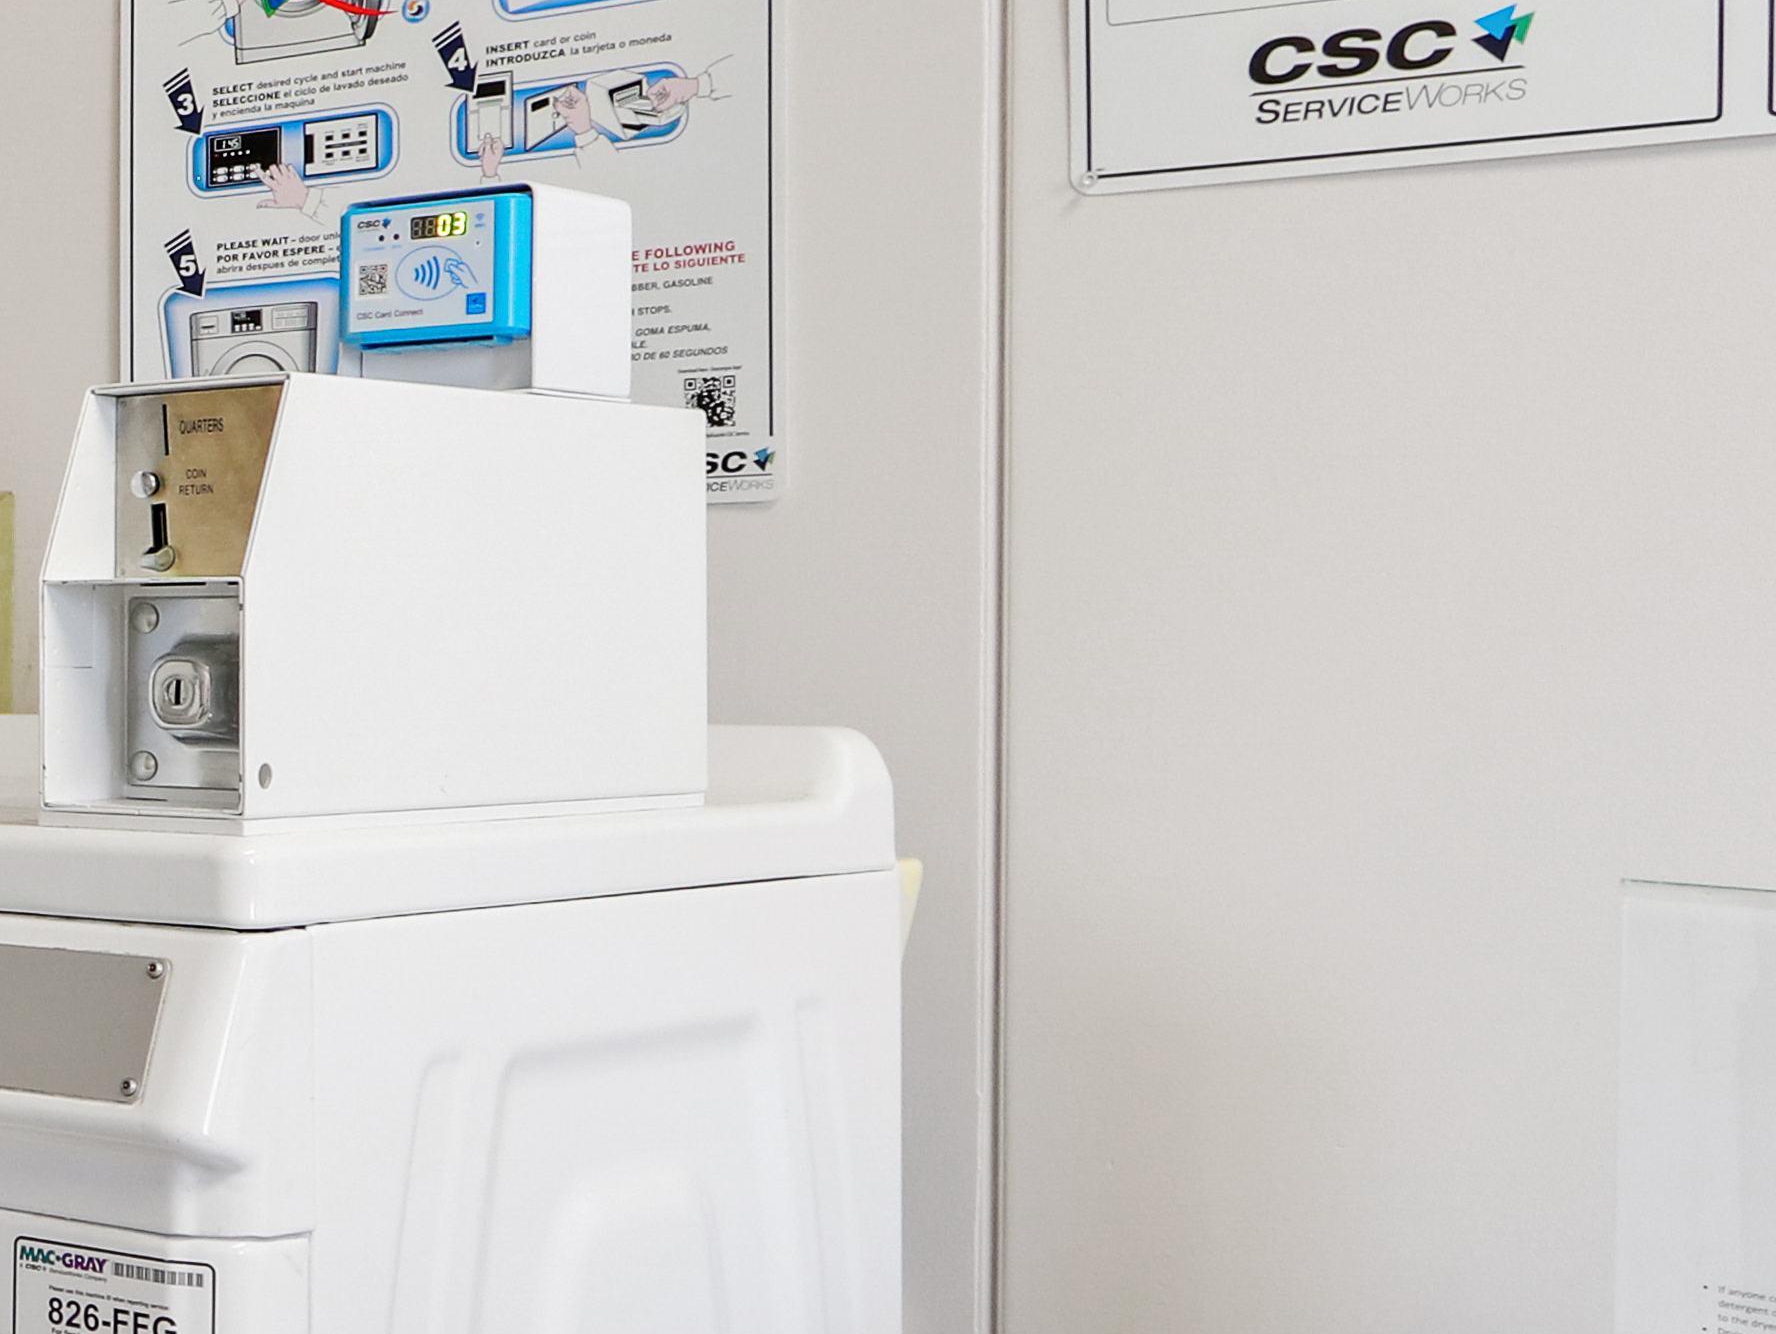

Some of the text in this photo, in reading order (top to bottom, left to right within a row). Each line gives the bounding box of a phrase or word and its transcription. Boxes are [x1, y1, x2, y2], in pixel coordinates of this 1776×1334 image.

[486, 31, 596, 54] INSERT card or coin
[448, 48, 467, 71] 4
[1249, 20, 1457, 85] CSC
[177, 93, 194, 115] 3
[358, 220, 380, 229] CSC
[217, 237, 289, 251] PLEASE WAIT
[645, 241, 735, 259] FOLLOWING
[179, 254, 196, 277] 5
[654, 254, 745, 271] LO SIGUIENTE
[180, 419, 223, 434] QUARTERS
[186, 470, 206, 478] COIN
[179, 485, 214, 495] RETURN
